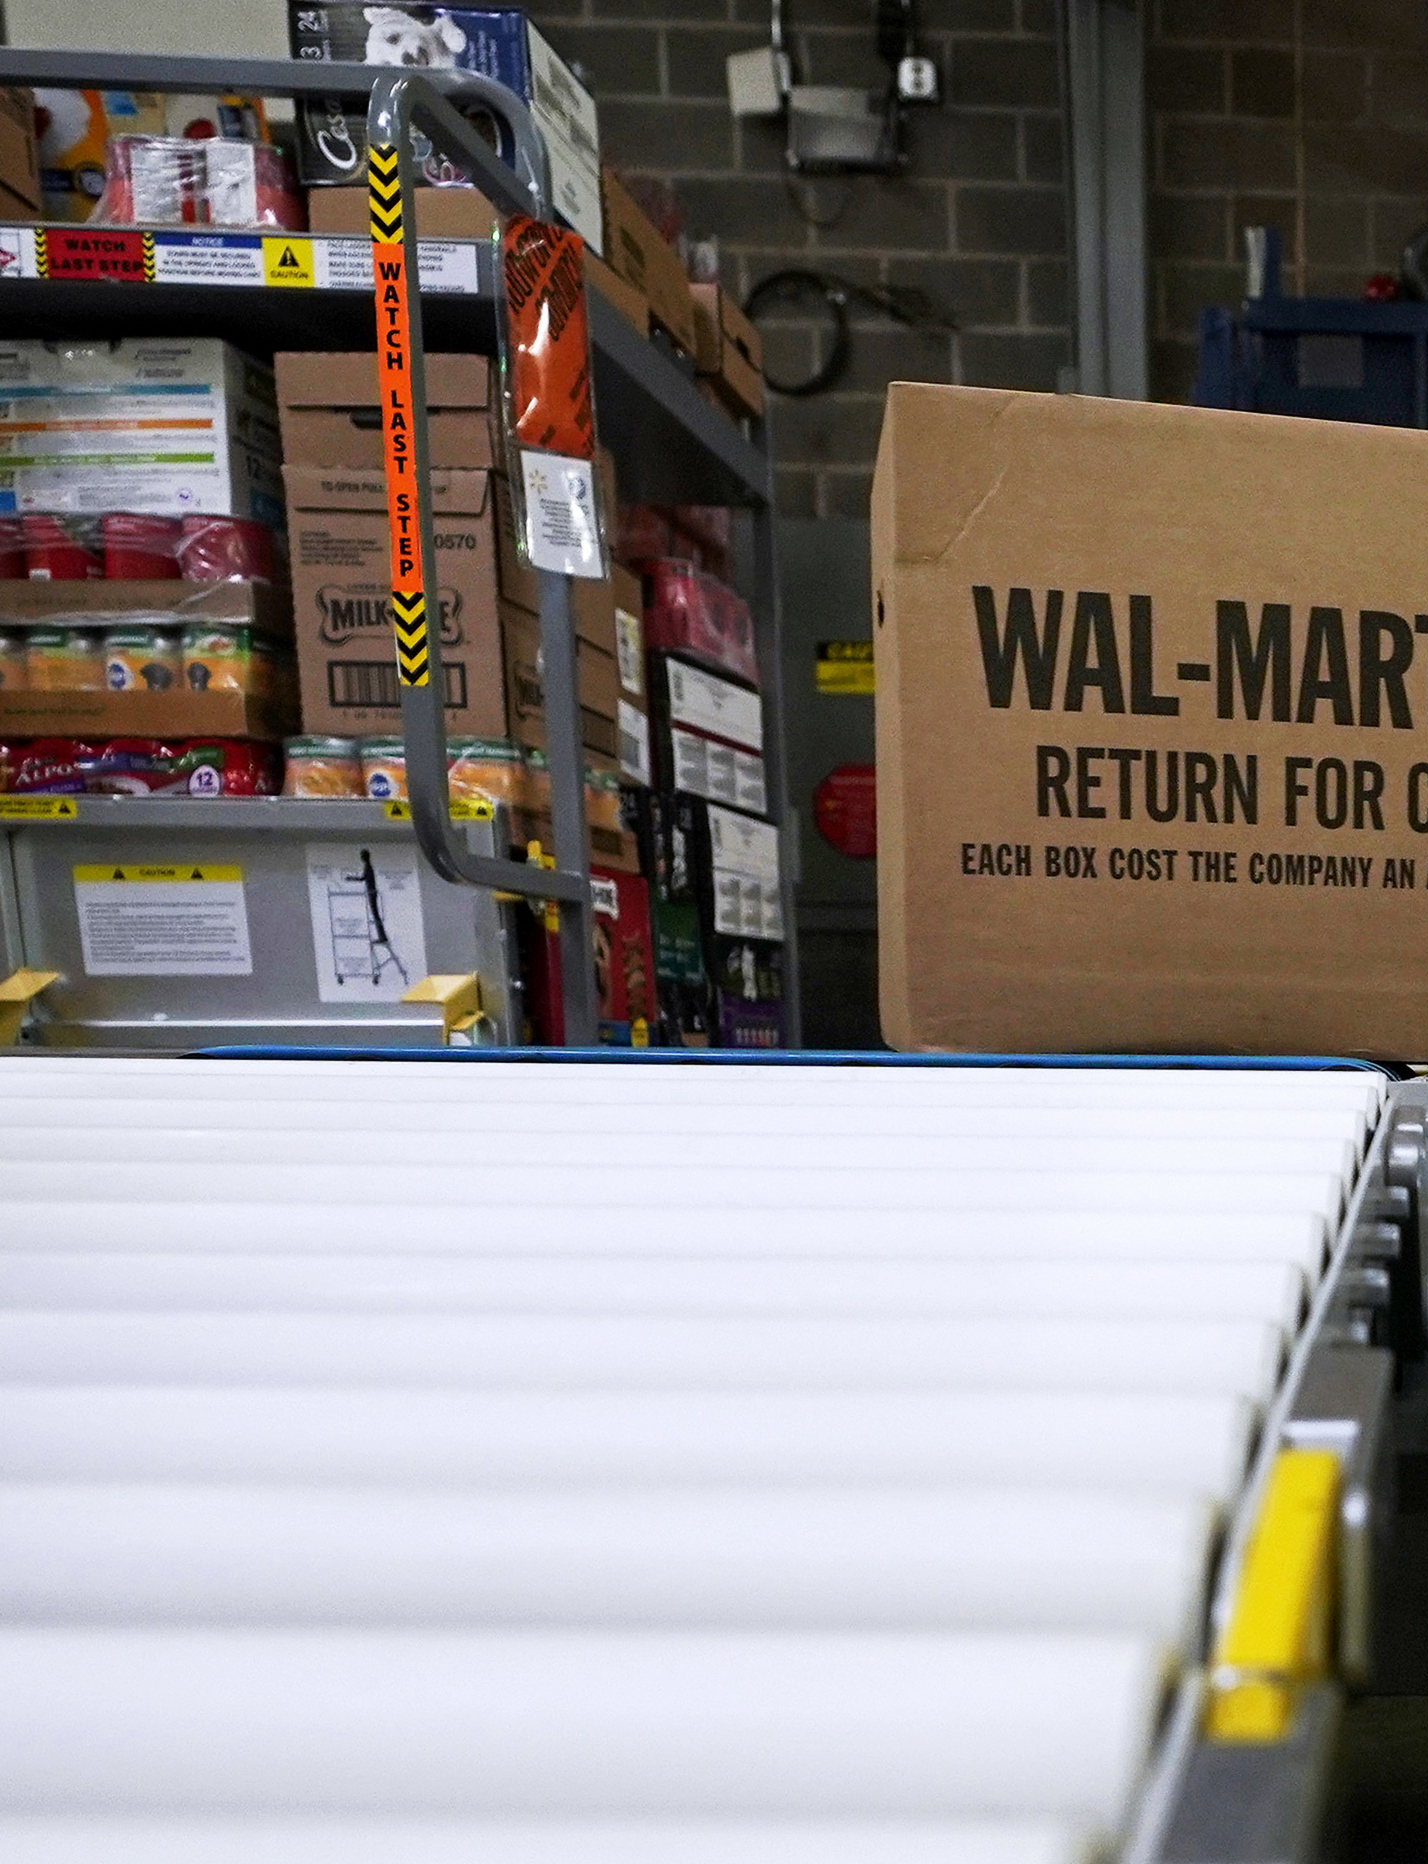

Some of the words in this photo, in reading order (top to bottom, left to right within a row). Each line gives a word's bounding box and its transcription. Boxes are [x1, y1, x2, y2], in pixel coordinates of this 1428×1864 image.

[51, 258, 94, 270] LAST
[100, 259, 143, 272] STEP
[66, 239, 126, 252] WATCH
[378, 261, 404, 371] WATCH
[390, 389, 409, 474] LAST
[397, 493, 414, 578] STEP
[1036, 744, 1258, 825] RETURN
[1284, 756, 1385, 831] FOR
[961, 843, 1032, 877] EACH
[1044, 845, 1098, 879] BOX
[1108, 847, 1178, 882] COST
[1187, 850, 1238, 884] THE
[1249, 852, 1373, 888] COMPANY
[1382, 858, 1416, 889] AN
